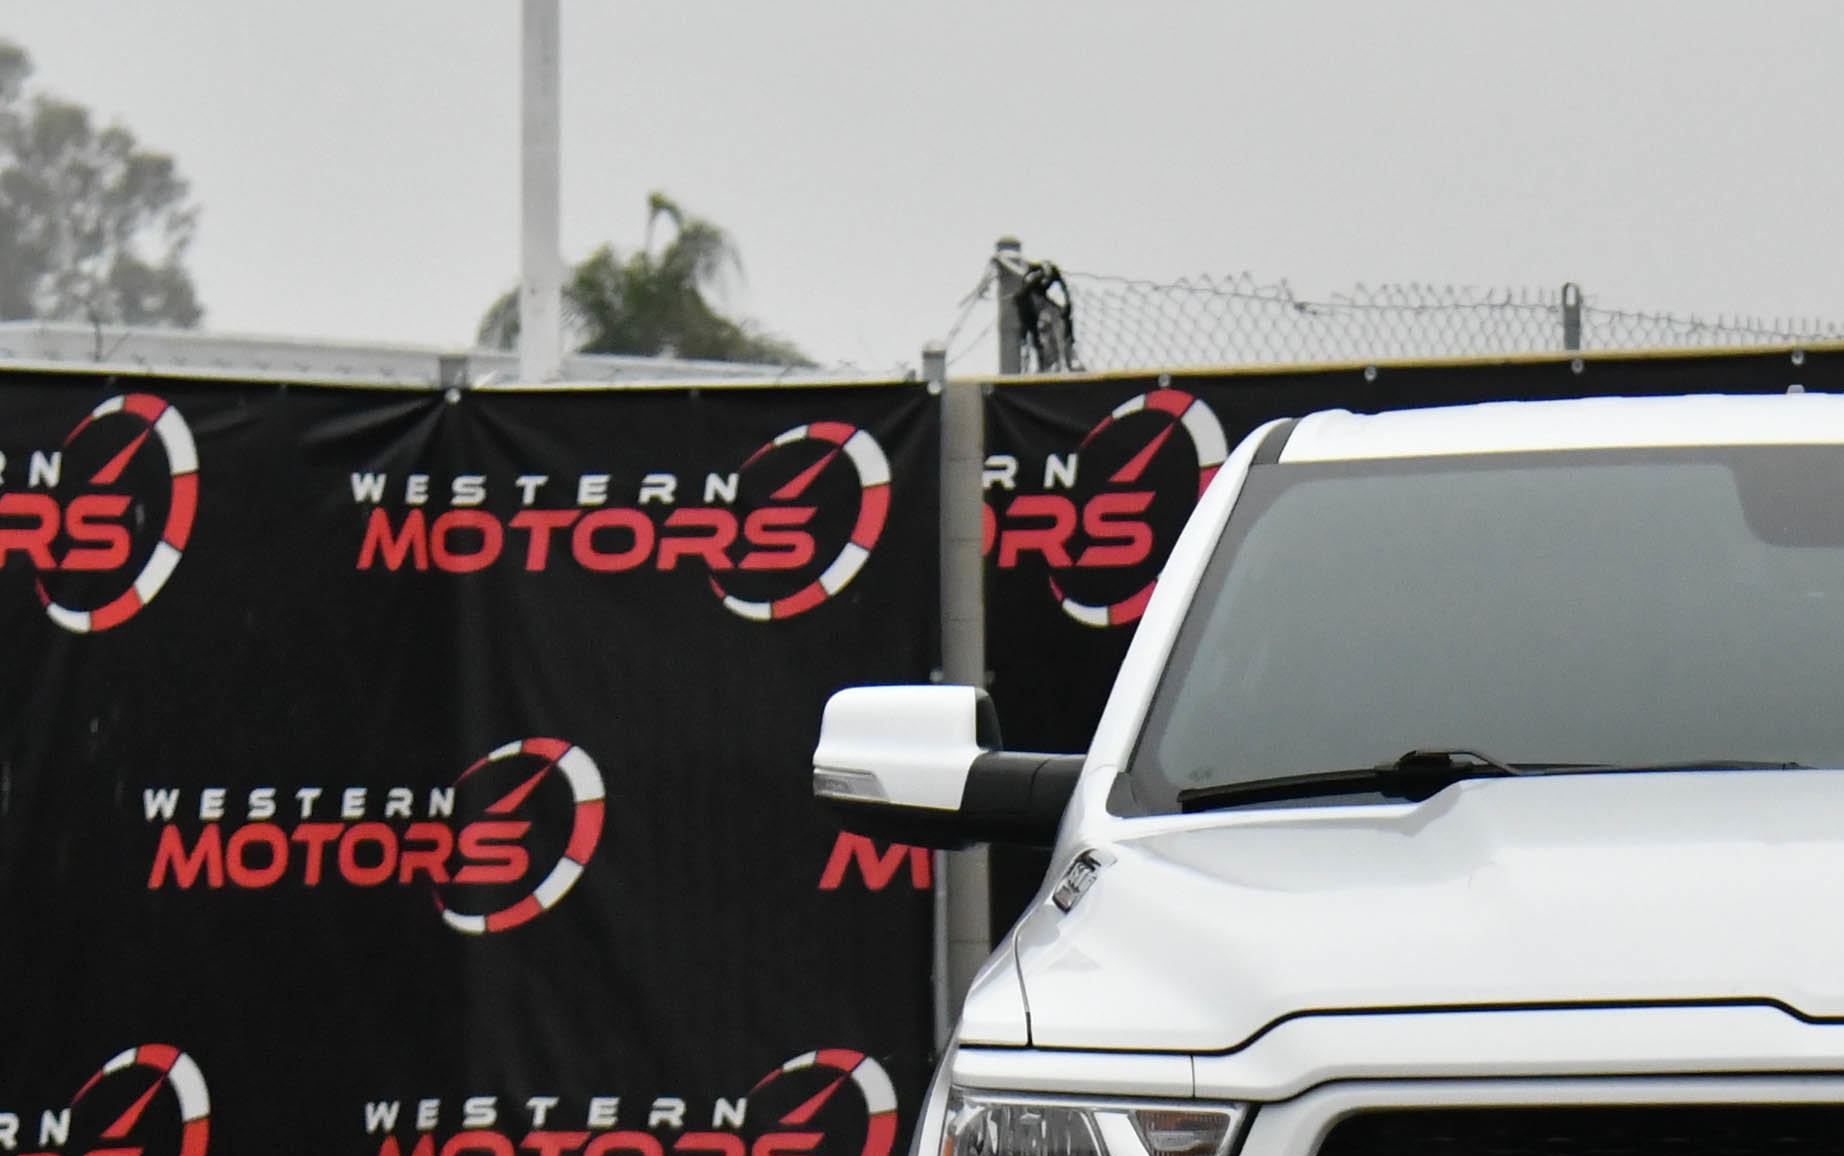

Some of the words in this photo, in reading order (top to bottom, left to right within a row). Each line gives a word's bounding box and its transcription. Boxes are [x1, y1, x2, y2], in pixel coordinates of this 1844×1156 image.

[351, 472, 739, 505] WESTERN
[357, 506, 817, 574] MOTORS
[144, 787, 455, 820] WESTERN
[149, 820, 531, 889] MOTORS
[365, 1096, 747, 1132] WESTERN
